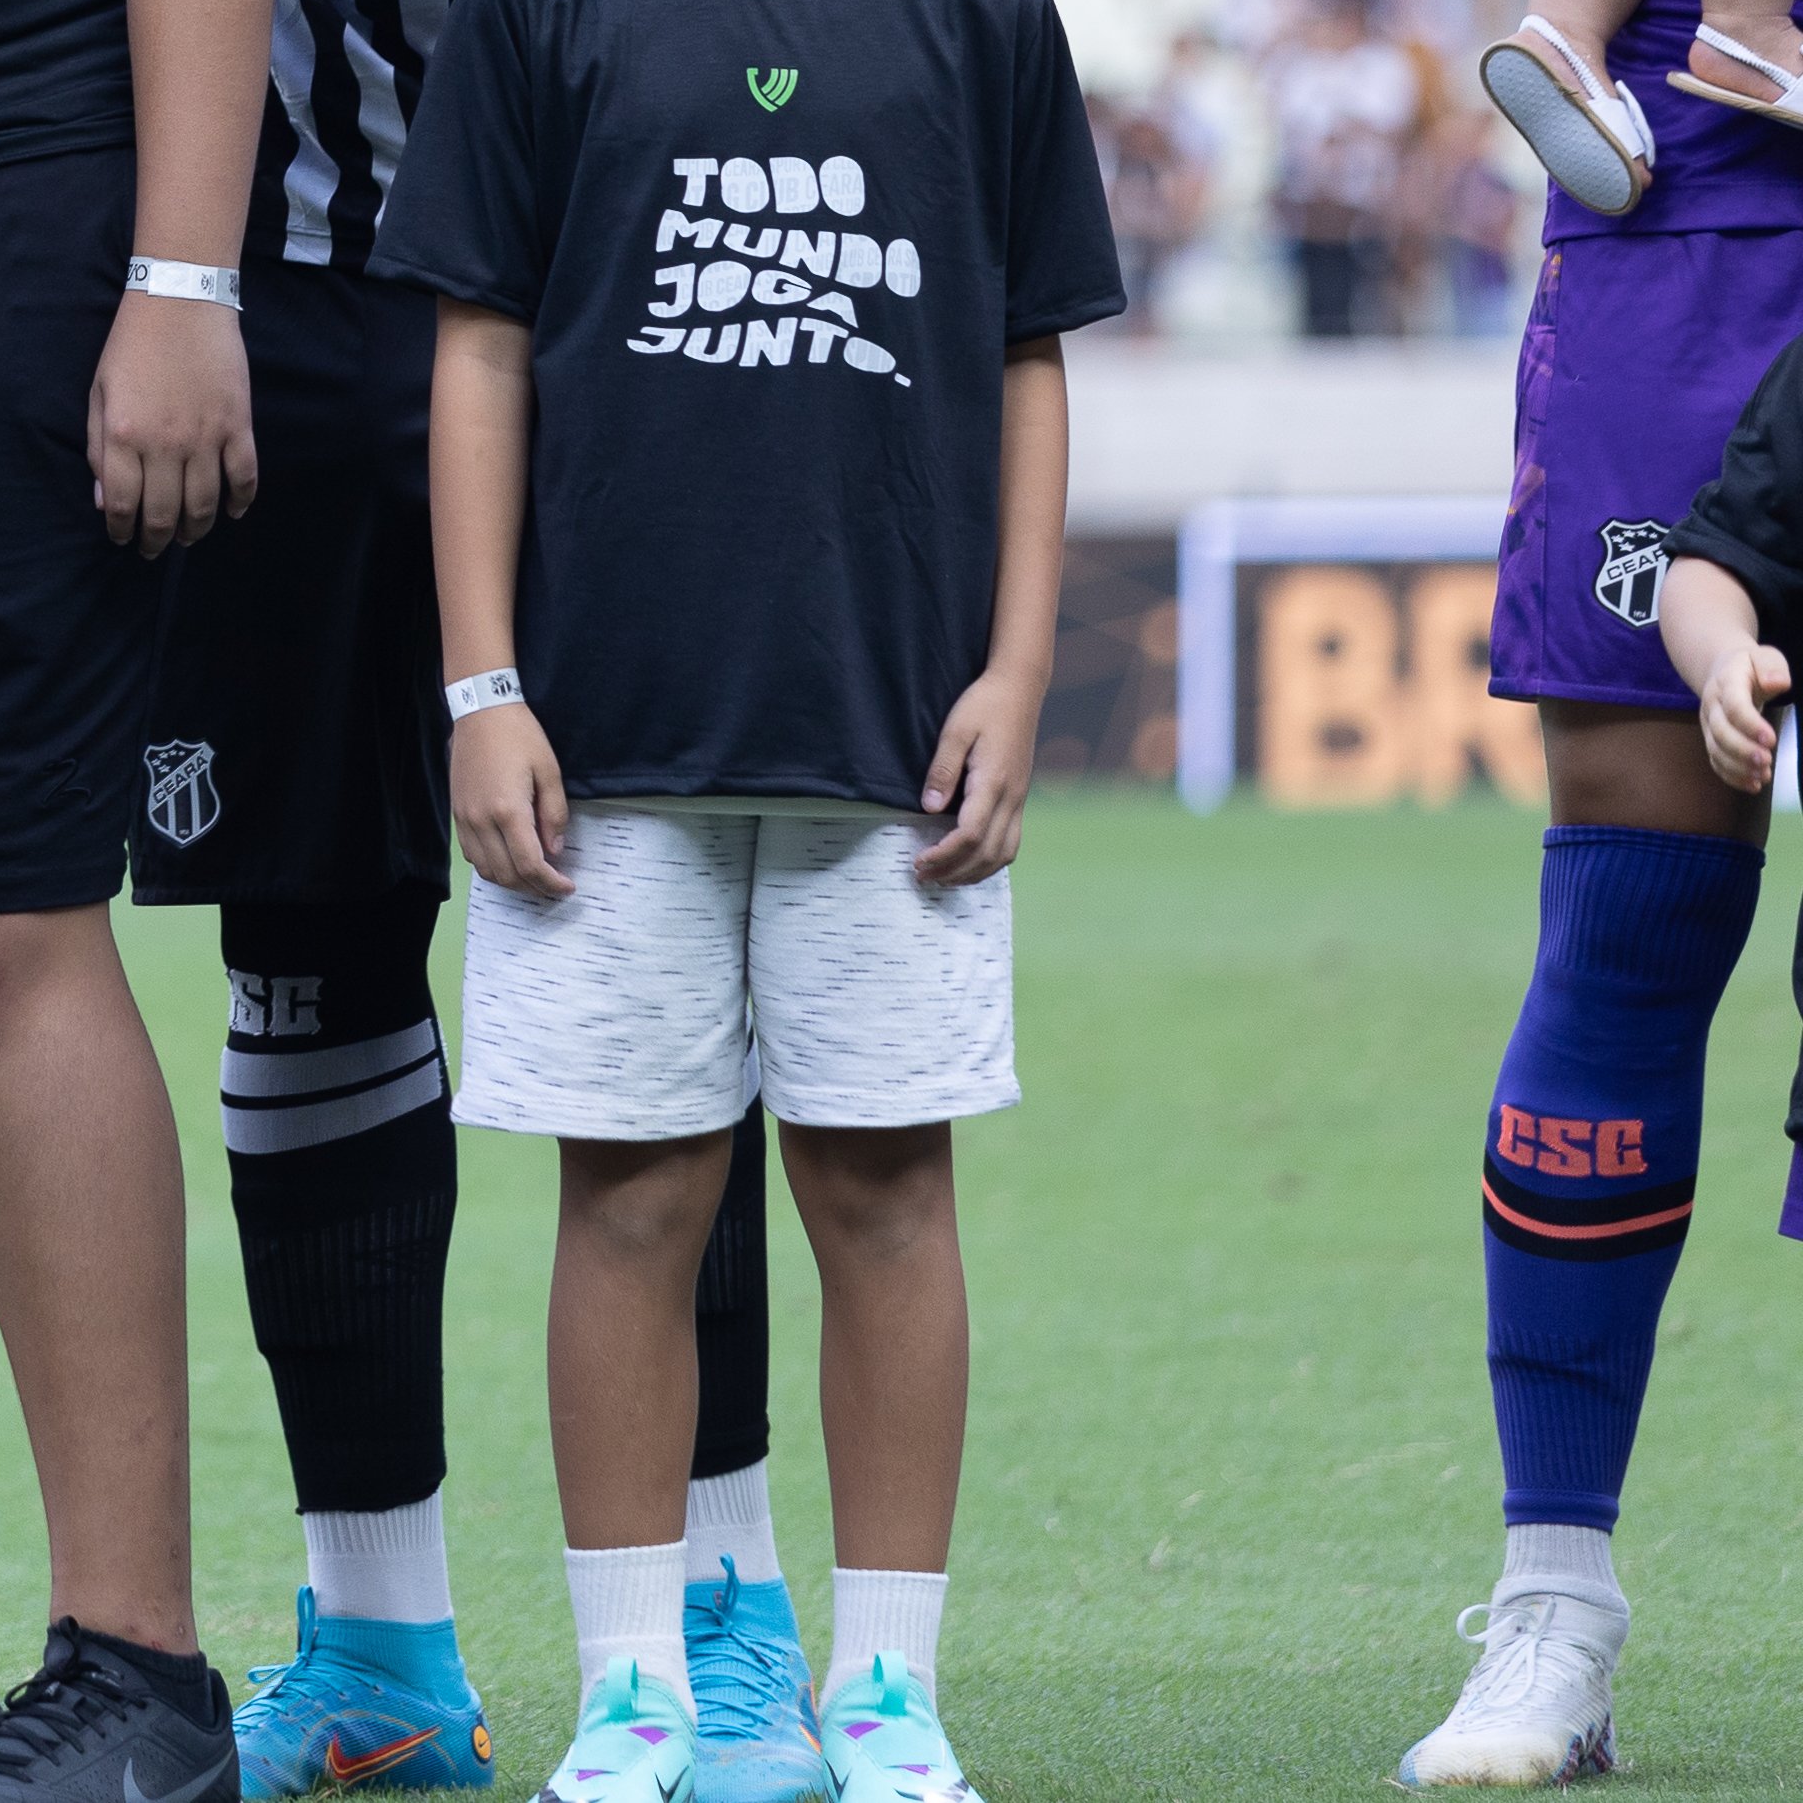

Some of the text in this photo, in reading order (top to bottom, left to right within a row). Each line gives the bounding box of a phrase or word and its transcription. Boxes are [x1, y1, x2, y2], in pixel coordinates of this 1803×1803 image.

[673, 155, 866, 217] TODO
[655, 209, 922, 298] MUNDO
[648, 260, 859, 329] JOGA
